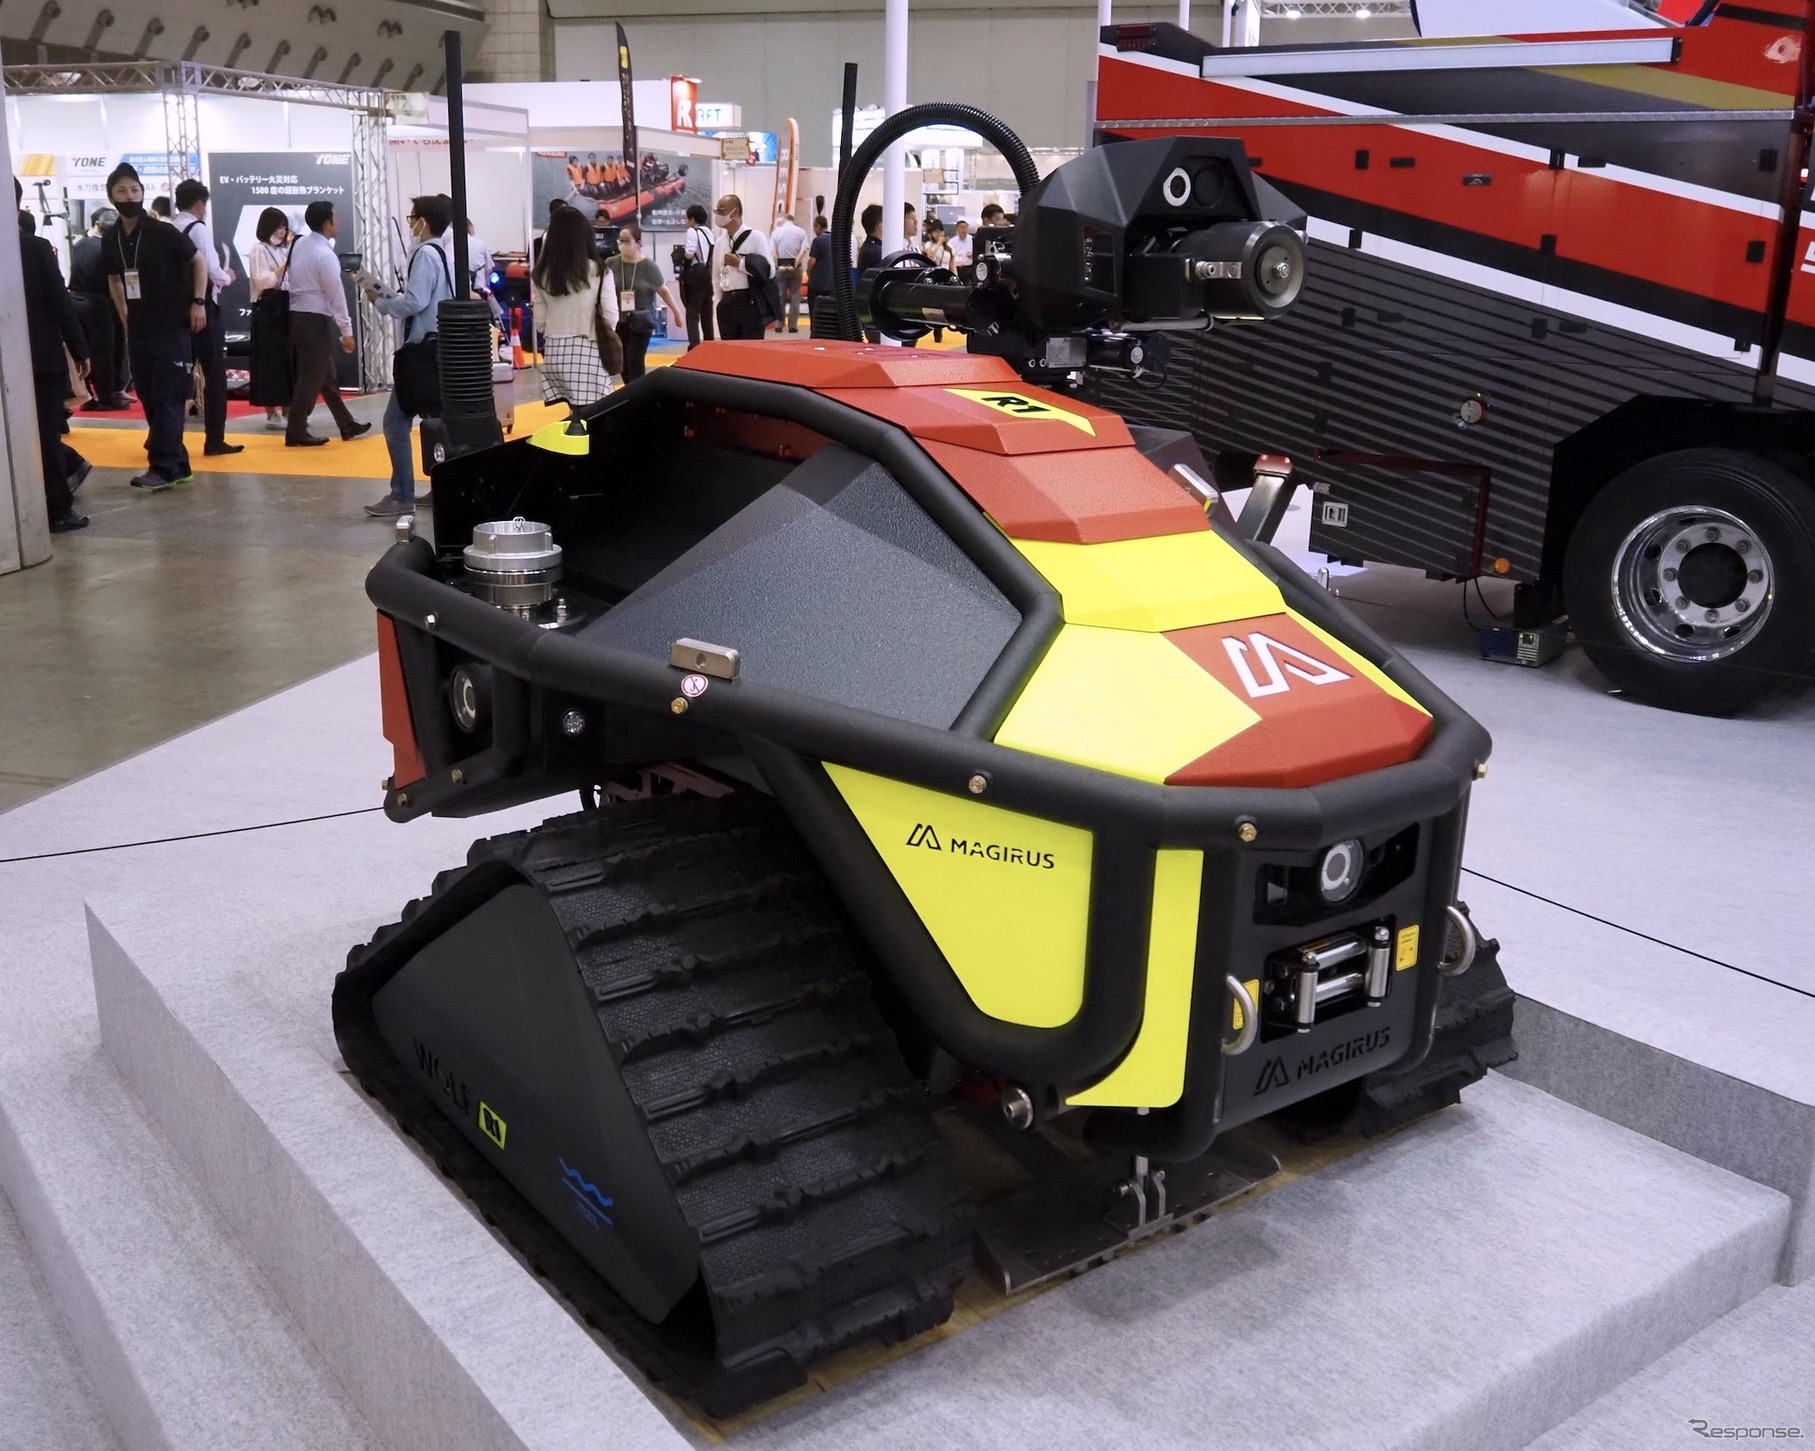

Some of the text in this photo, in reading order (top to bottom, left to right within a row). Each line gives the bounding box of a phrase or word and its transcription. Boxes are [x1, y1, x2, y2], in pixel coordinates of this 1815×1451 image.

[981, 396, 1052, 413] R1
[951, 838, 1055, 870] MAGIRUS
[1297, 1026, 1391, 1080] MAGIRUS
